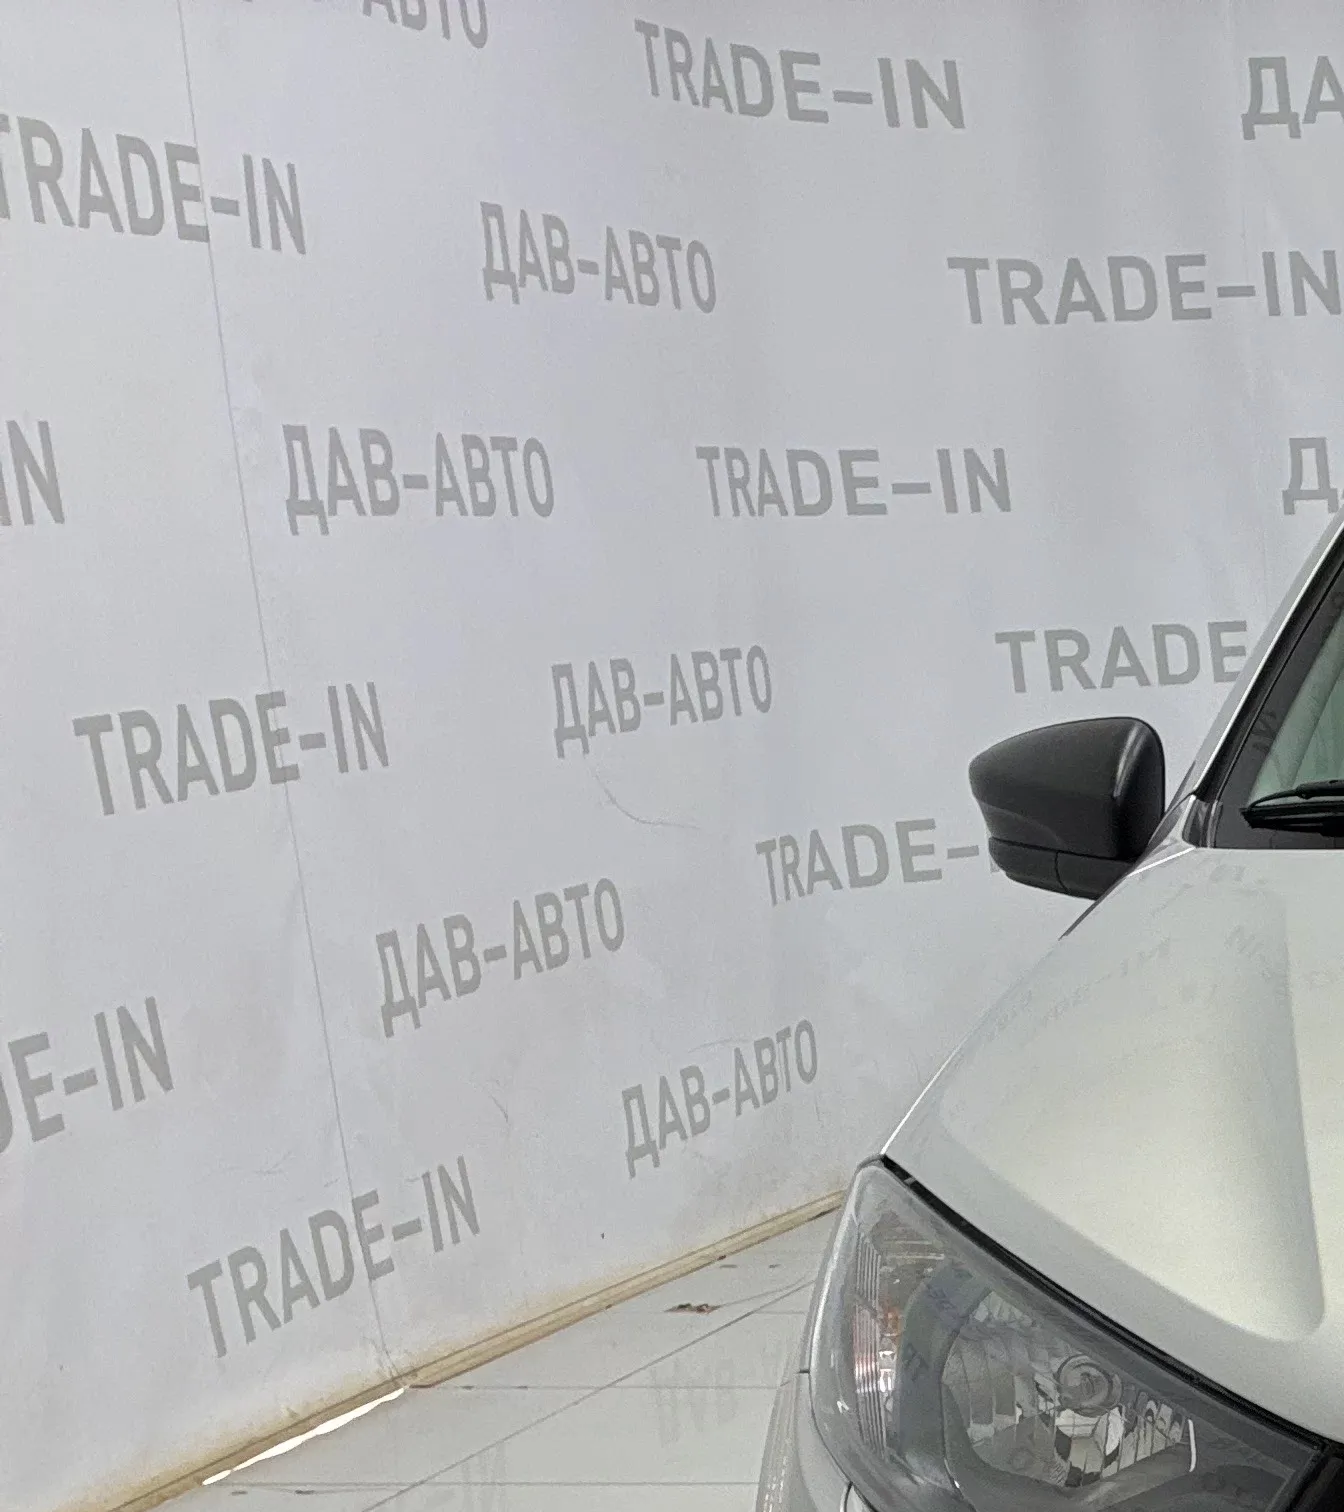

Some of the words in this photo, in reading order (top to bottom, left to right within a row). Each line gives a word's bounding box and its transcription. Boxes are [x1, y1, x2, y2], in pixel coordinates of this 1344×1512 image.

[634, 20, 965, 130] TRADE-IN
[480, 201, 717, 315] ДАВ-АВТО
[947, 250, 1343, 325] TRADE-IN
[282, 424, 554, 536] ДАВ-АВТО
[695, 446, 1012, 518] TRADE-IN
[73, 682, 389, 817] TRADE-IN
[551, 644, 772, 759] ДАВ-АВТО
[755, 819, 1000, 906] TRADE-
[374, 878, 625, 1037] ДАВ-АВТО
[620, 1019, 819, 1178] ДАВ-АВТО
[187, 1156, 481, 1360] TRADE-IN
